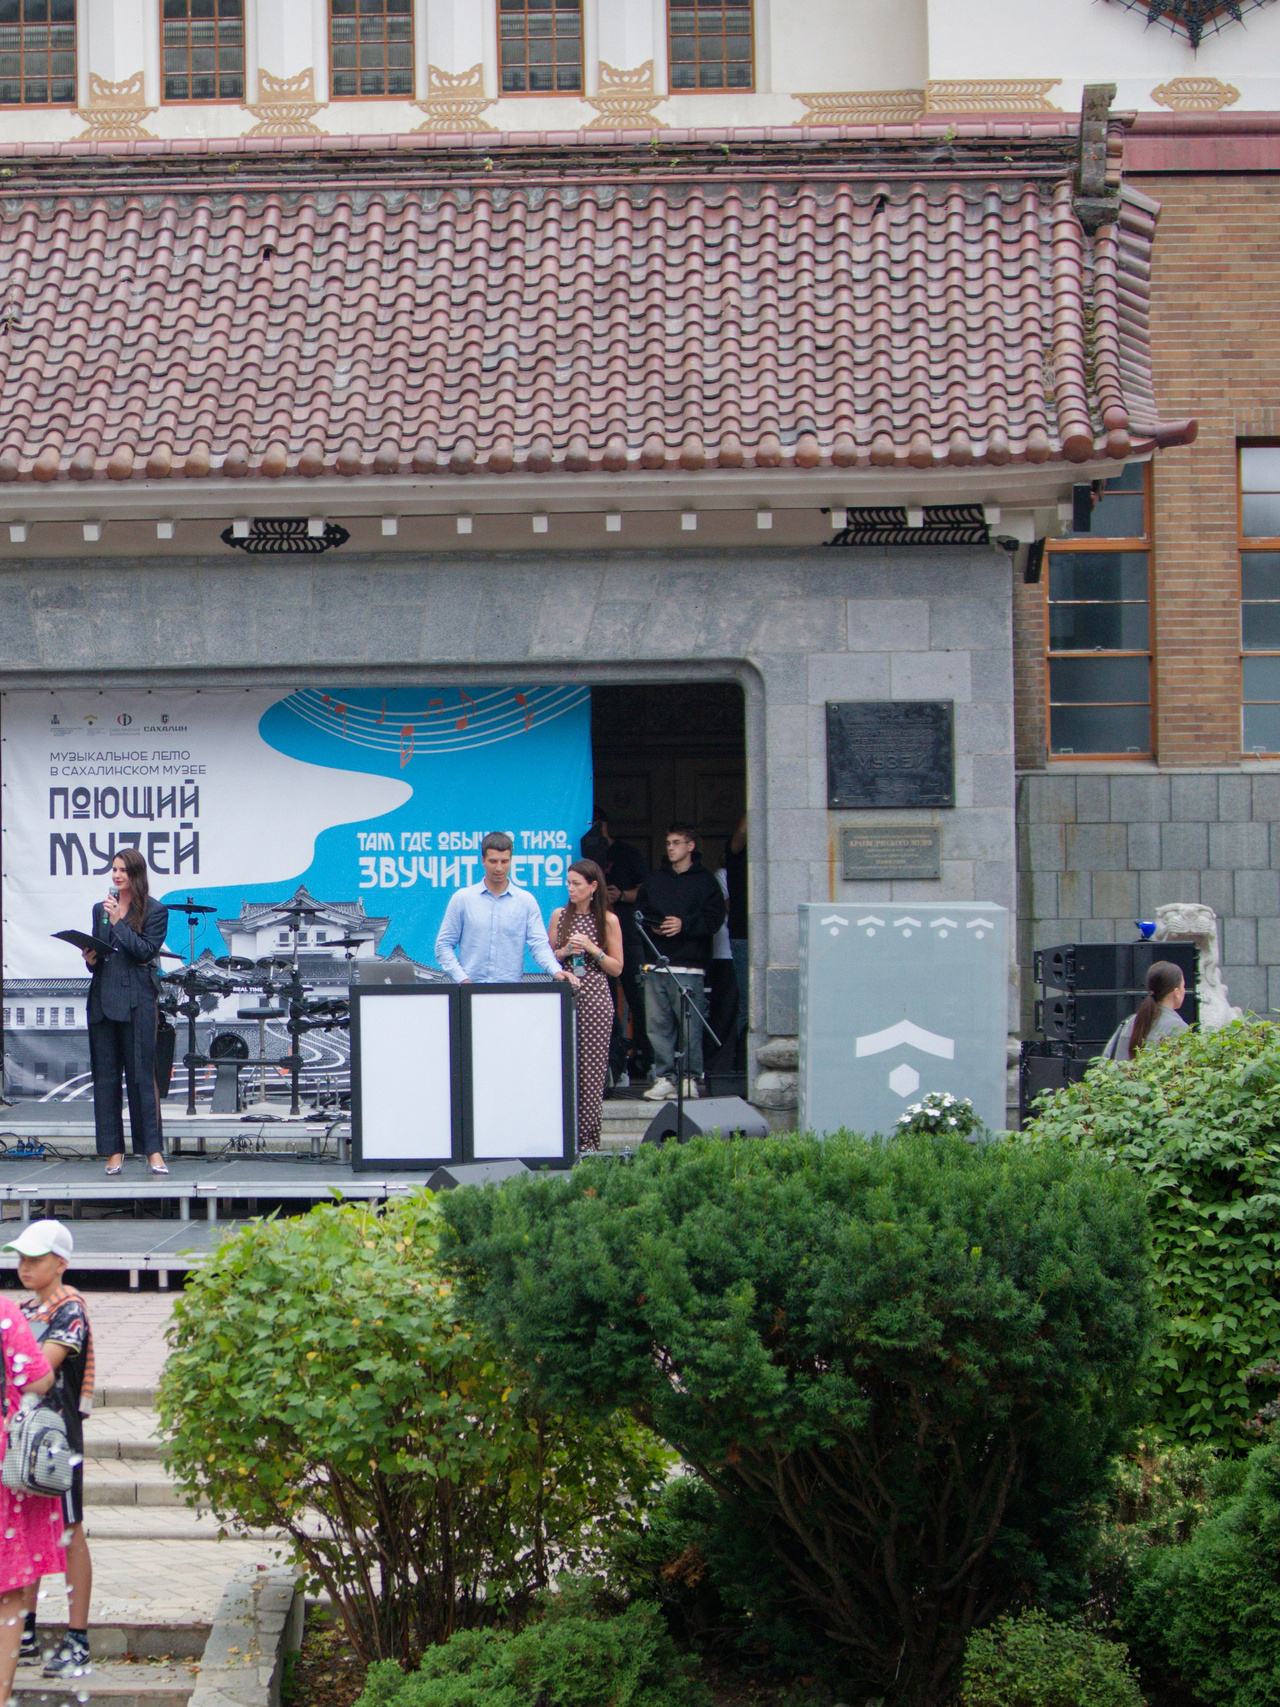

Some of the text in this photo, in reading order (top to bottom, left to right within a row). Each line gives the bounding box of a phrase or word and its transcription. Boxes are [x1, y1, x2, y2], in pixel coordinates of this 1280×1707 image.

[50, 750, 191, 762] МУЗЫКАЛЬНОЕ ЛЕТО
[854, 753, 930, 771] МУЗЕЙ
[50, 765, 207, 776] В САХАЛИНСКОМ МУЗЕЕ
[49, 779, 199, 821] ПОЮЩИЙ
[357, 832, 394, 851] ТАМ
[401, 833, 432, 852] ГДЕ
[520, 830, 573, 850] ТИХО,
[359, 855, 572, 889] ЗВУЧИТ ЕТО!
